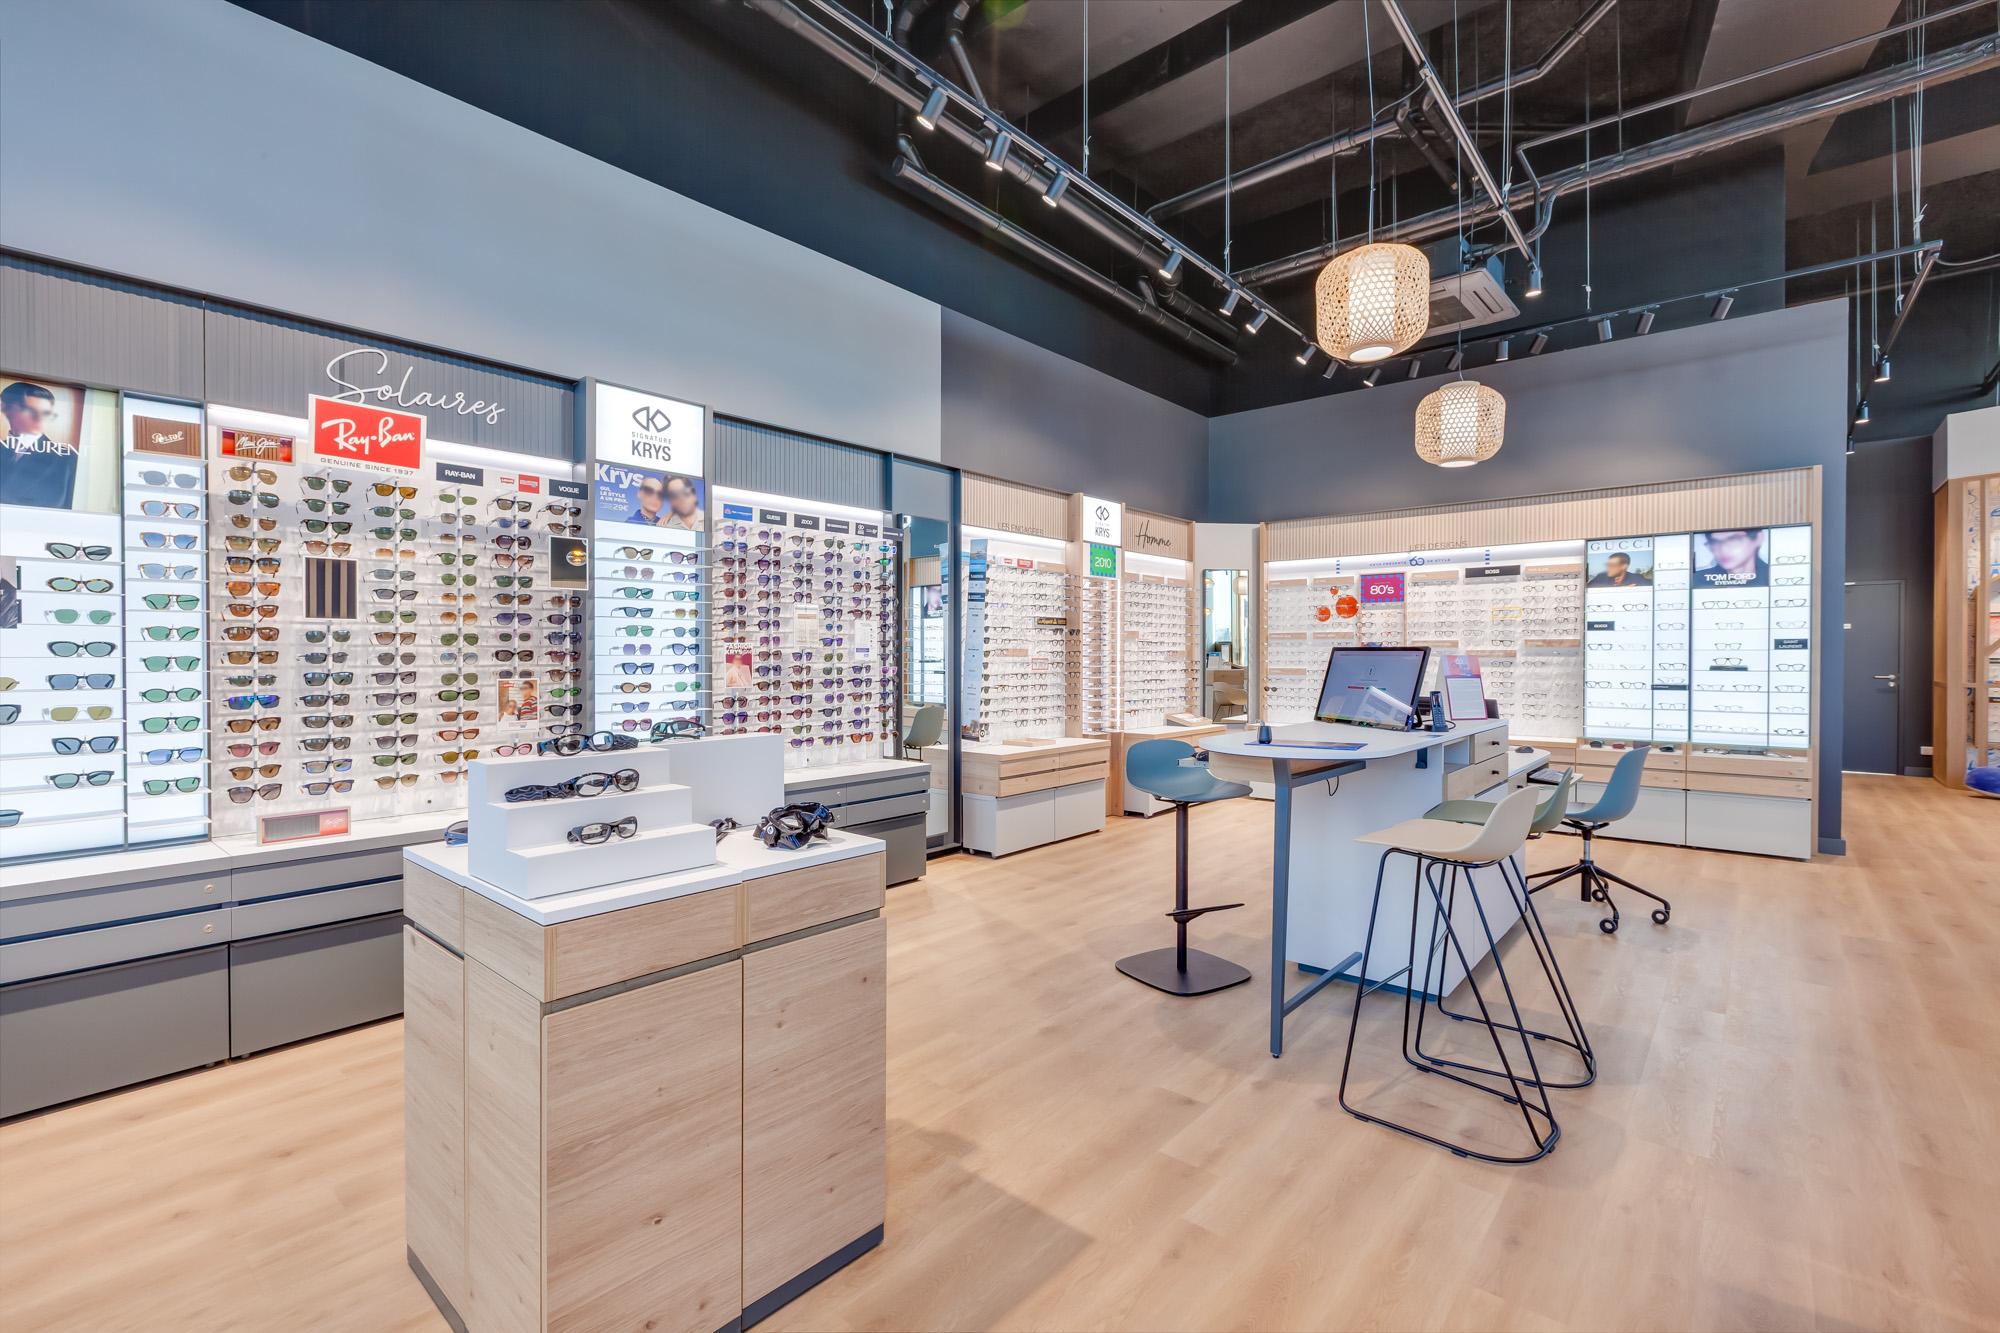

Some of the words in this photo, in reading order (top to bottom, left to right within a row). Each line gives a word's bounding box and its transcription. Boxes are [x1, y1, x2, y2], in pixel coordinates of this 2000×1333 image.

[326, 349, 505, 424] Solaires
[321, 416, 415, 455] Ray-Ban
[631, 431, 672, 444] SIGNATURE
[631, 439, 672, 461] KRYS
[320, 457, 361, 469] GENUINE
[365, 463, 390, 473] SINCE
[394, 468, 414, 476] 1937
[445, 469, 476, 480] RAY-BAN
[594, 463, 644, 489] Krys
[558, 486, 580, 494] VOGUE
[1095, 526, 1110, 538] KRYS
[1135, 520, 1171, 549] Homme
[1590, 539, 1650, 552] GUCCI
[1094, 556, 1112, 569] 2010
[1704, 574, 1728, 582] TOM
[1728, 572, 1757, 581] FORD
[1370, 584, 1395, 595] 80's
